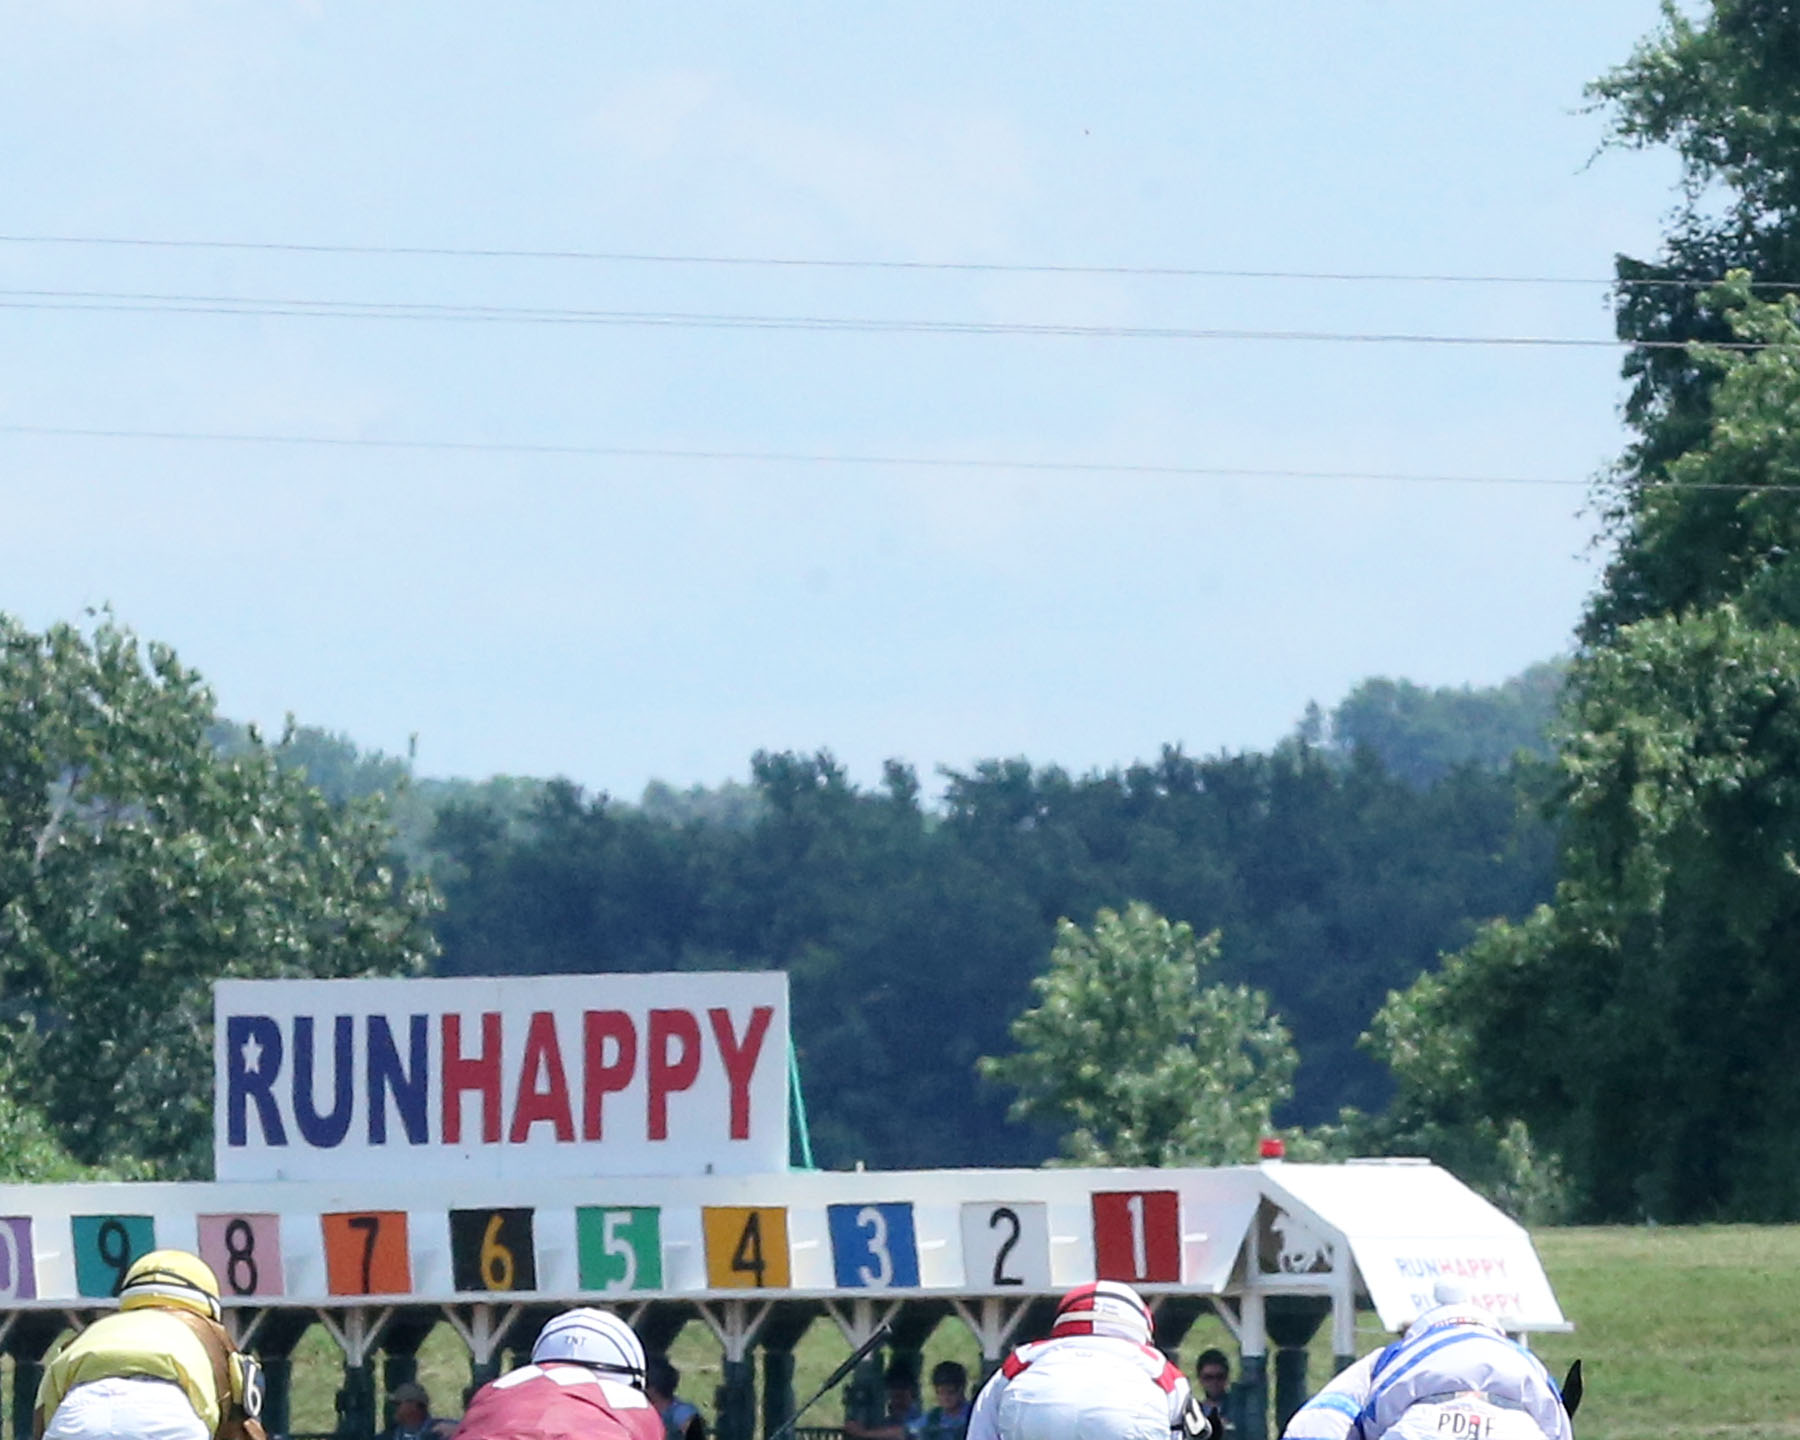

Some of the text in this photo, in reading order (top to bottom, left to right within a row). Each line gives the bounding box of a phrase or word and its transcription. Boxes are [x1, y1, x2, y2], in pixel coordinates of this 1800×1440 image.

[227, 1007, 774, 1148] RUNHAPPY
[98, 1221, 130, 1297] 9
[225, 1219, 258, 1296] 8
[349, 1217, 379, 1294] 7
[481, 1213, 514, 1291] 6
[603, 1211, 637, 1290] 5
[731, 1211, 765, 1287] 4
[856, 1207, 893, 1287] 3
[990, 1207, 1023, 1285] 2
[1127, 1195, 1147, 1279] 1
[1395, 1257, 1507, 1278] RUNHAPPY
[247, 1363, 262, 1416] 6
